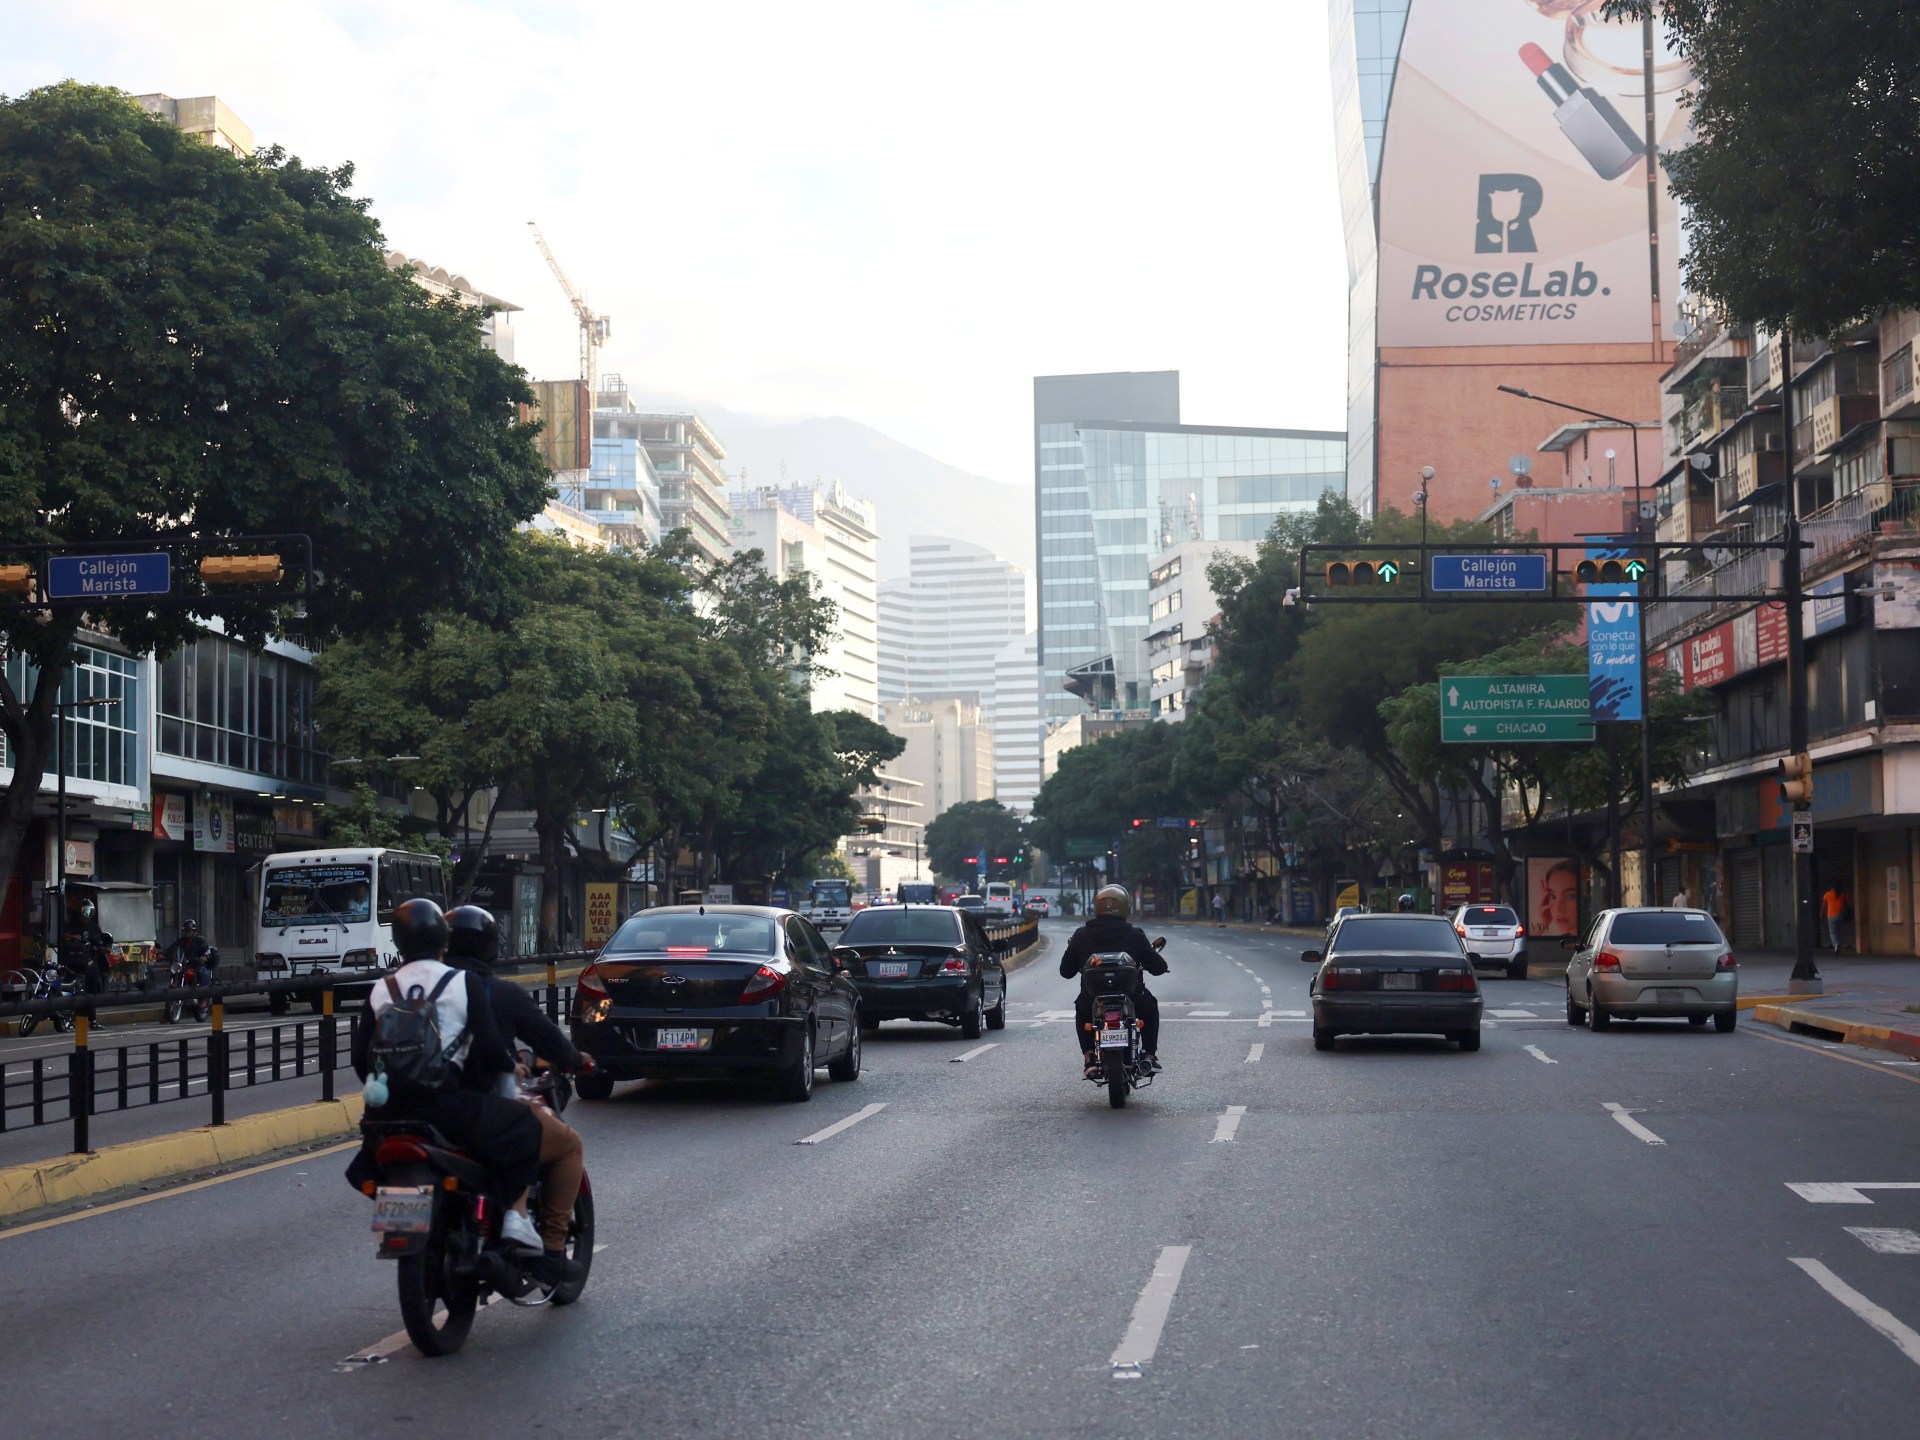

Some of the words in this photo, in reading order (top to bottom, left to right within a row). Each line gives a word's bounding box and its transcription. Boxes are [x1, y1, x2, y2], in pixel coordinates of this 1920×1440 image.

[1411, 261, 1611, 300] RoseLab.
[1445, 303, 1578, 322] COSMETICS
[79, 559, 137, 577] Callejón
[1461, 559, 1516, 575] Callejón
[82, 577, 137, 592] Marista
[1464, 575, 1516, 588] Marista
[1591, 630, 1635, 642] Conecta
[1592, 643, 1607, 651] con
[1609, 642, 1617, 651] lo
[1618, 643, 1635, 652] que
[1606, 653, 1636, 665] mueve
[1488, 684, 1546, 694] ALTAMIRA
[1462, 699, 1525, 710] AUTOPISTA
[1527, 699, 1535, 709] F.
[1538, 698, 1591, 709] FAJARDO
[1497, 723, 1546, 733] CHACAO
[590, 892, 612, 900] AAA
[589, 909, 612, 917] MAA
[659, 1032, 696, 1044] AF114PM
